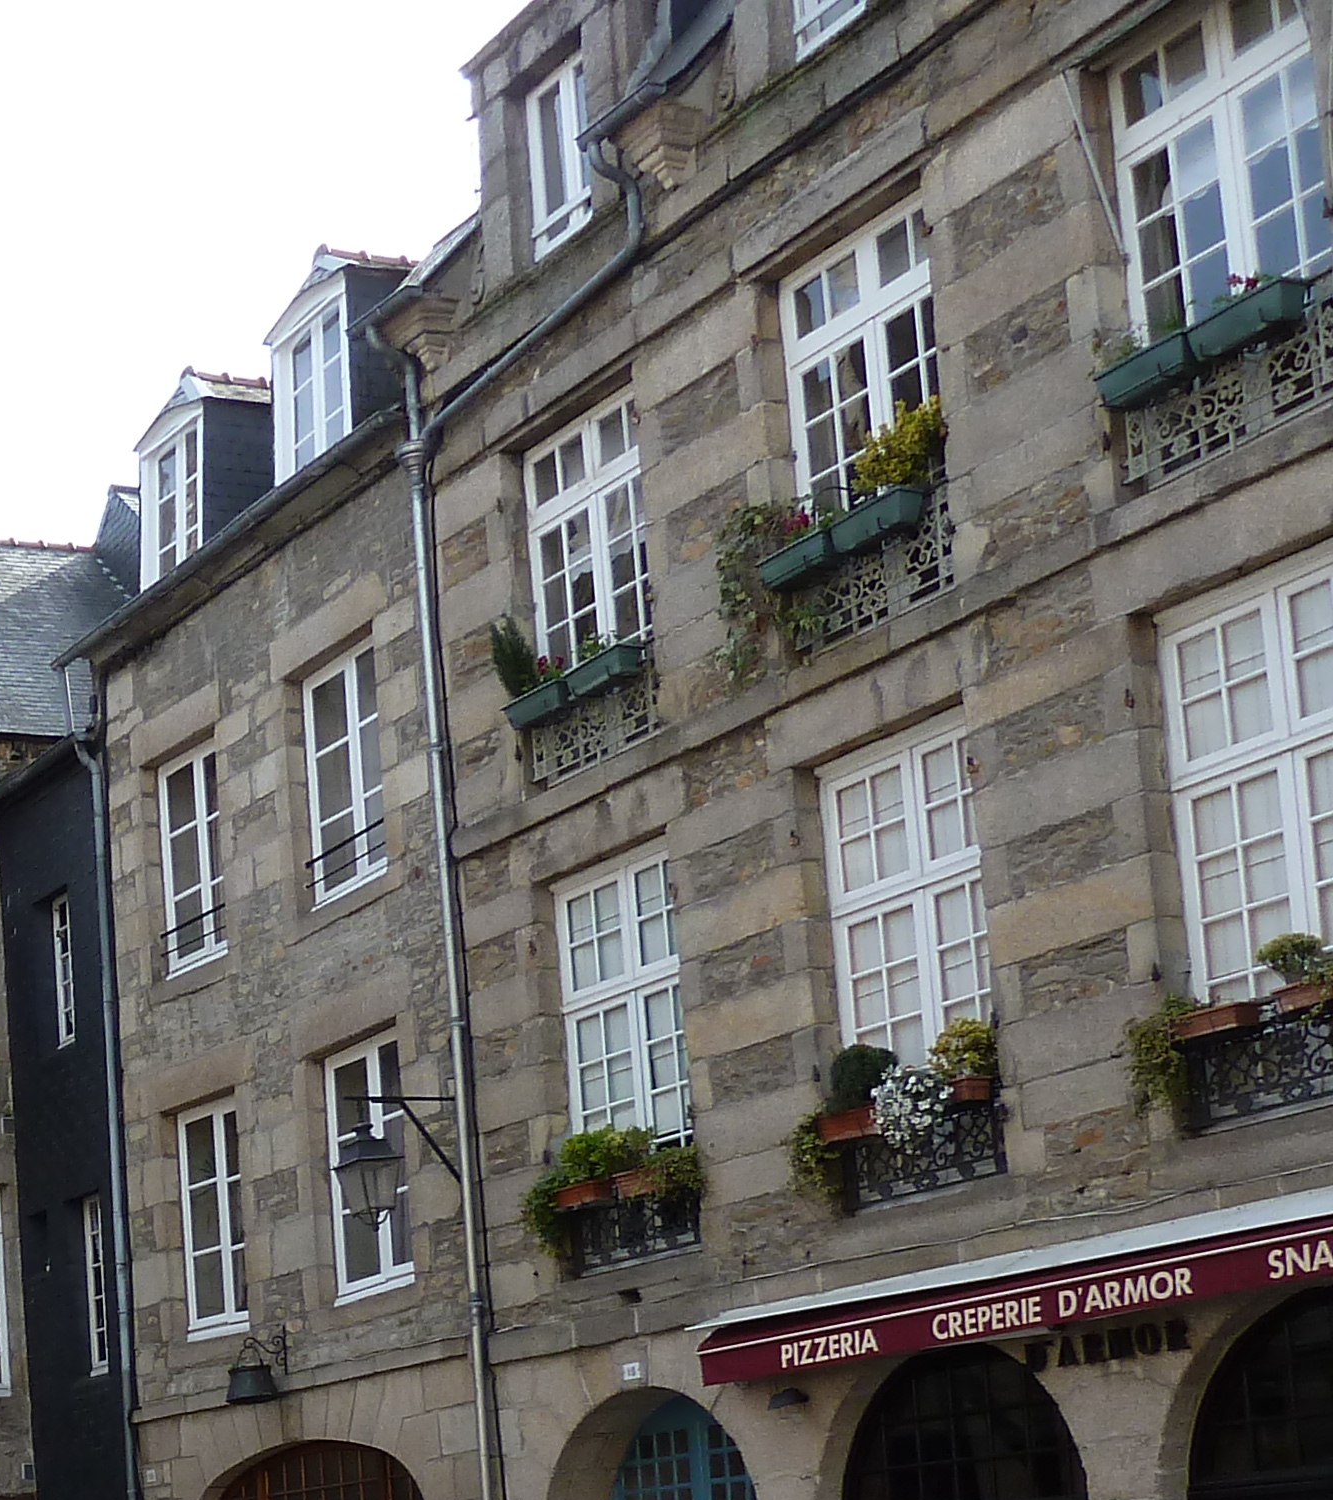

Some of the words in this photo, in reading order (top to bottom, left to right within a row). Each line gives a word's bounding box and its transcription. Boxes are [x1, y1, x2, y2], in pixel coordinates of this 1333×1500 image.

[780, 1328, 879, 1369] PIZZERIA
[932, 1297, 1042, 1341] CREPERIE
[1057, 1268, 1194, 1318] D'ARMOR
[1268, 1240, 1333, 1279] SNA
